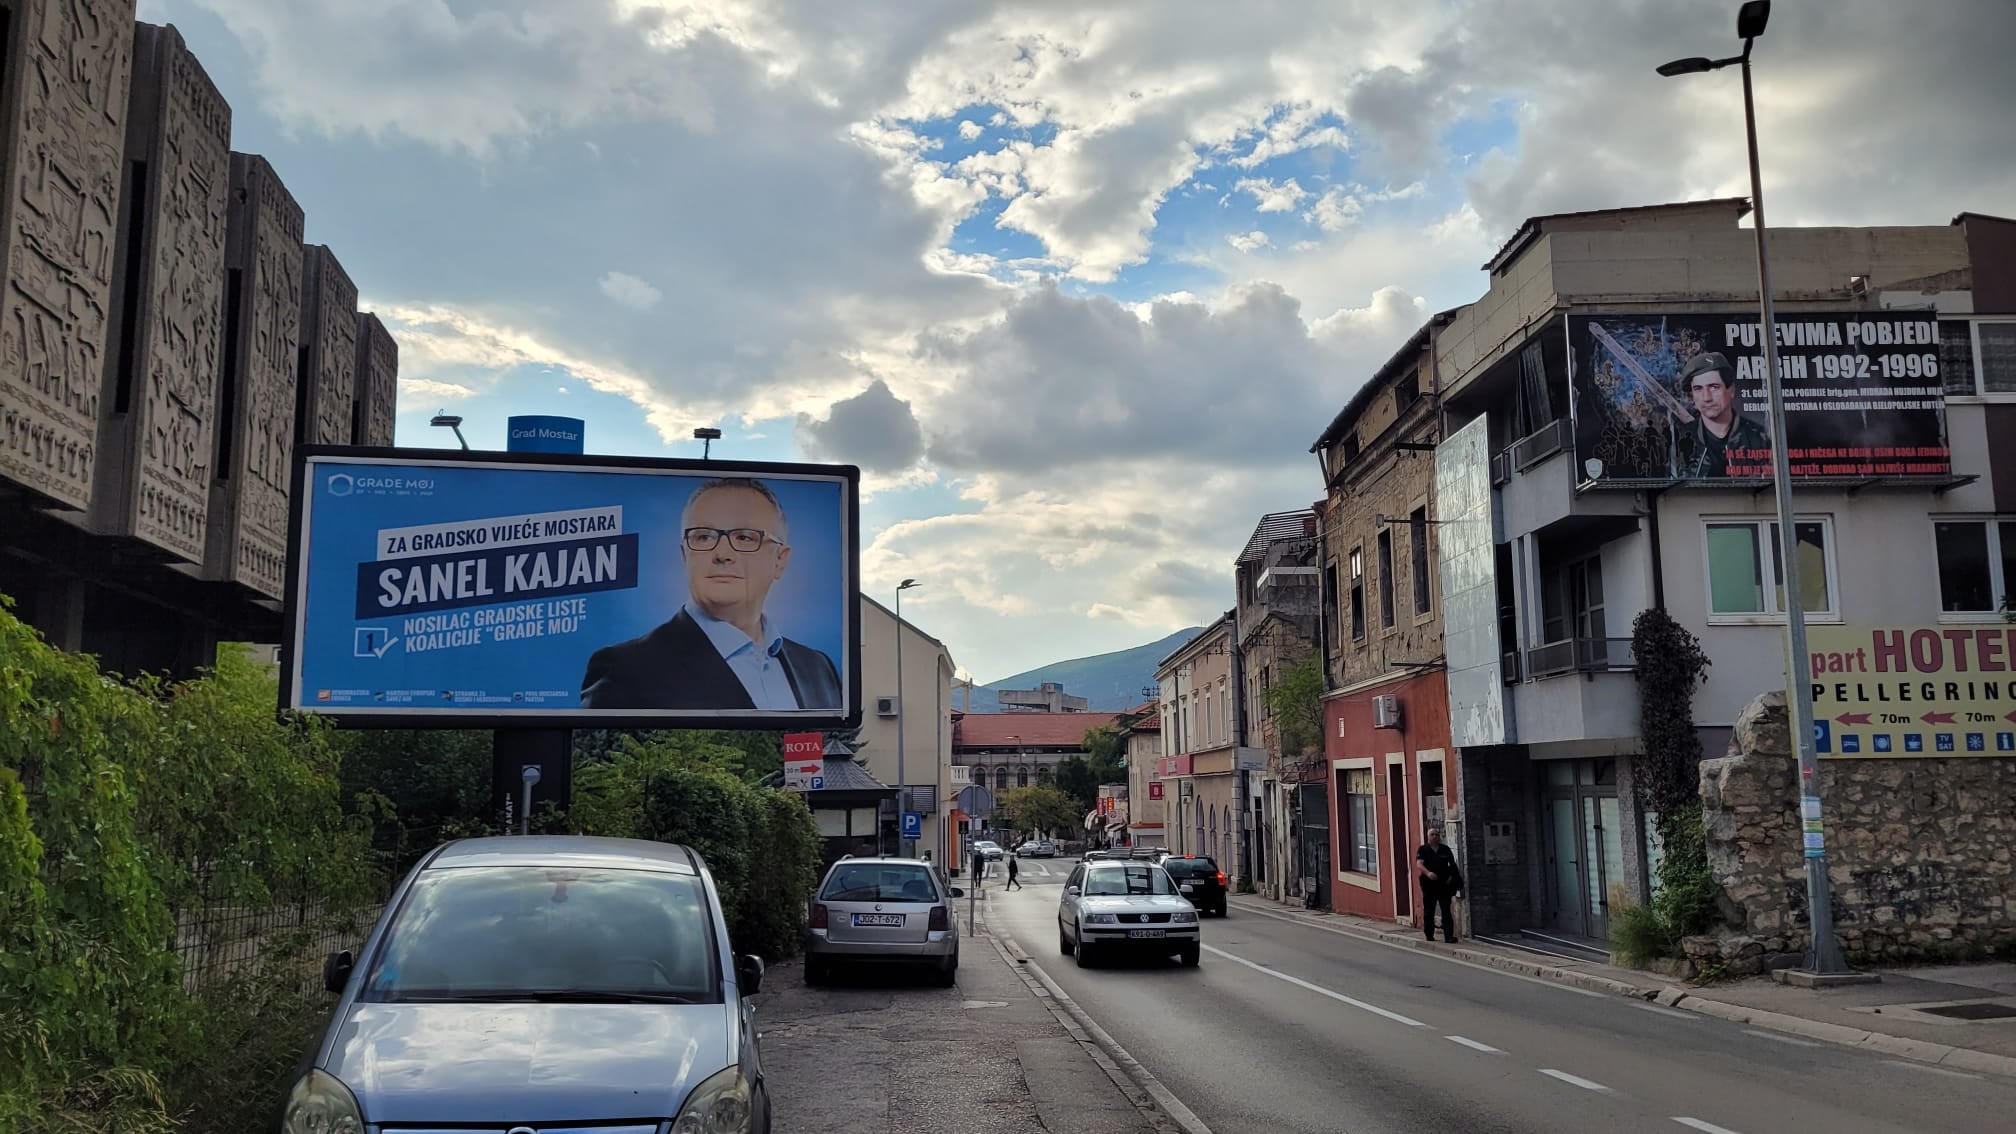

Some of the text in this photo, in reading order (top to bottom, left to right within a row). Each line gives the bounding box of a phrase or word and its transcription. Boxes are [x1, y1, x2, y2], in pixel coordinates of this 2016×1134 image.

[1725, 322, 1843, 346] PUTEVIMA
[1811, 353, 1938, 378] 1992-1996
[1784, 402, 1818, 411] MOSTARA
[512, 428, 578, 440] Grad Mostar
[357, 477, 402, 489] GRADE
[387, 514, 617, 554] ZA GRADSKO VIJEĆE MOSTARA
[378, 543, 618, 608] SANEL KAJAN
[404, 598, 587, 636] NOSILAC GRADSKE LISTE
[365, 632, 374, 652] 1
[405, 629, 481, 653] KOALICIJE
[1880, 713, 1911, 724] 70m
[1966, 712, 1996, 722] 70m
[786, 742, 820, 753] ROTA
[813, 778, 822, 788] P
[905, 815, 916, 829] P
